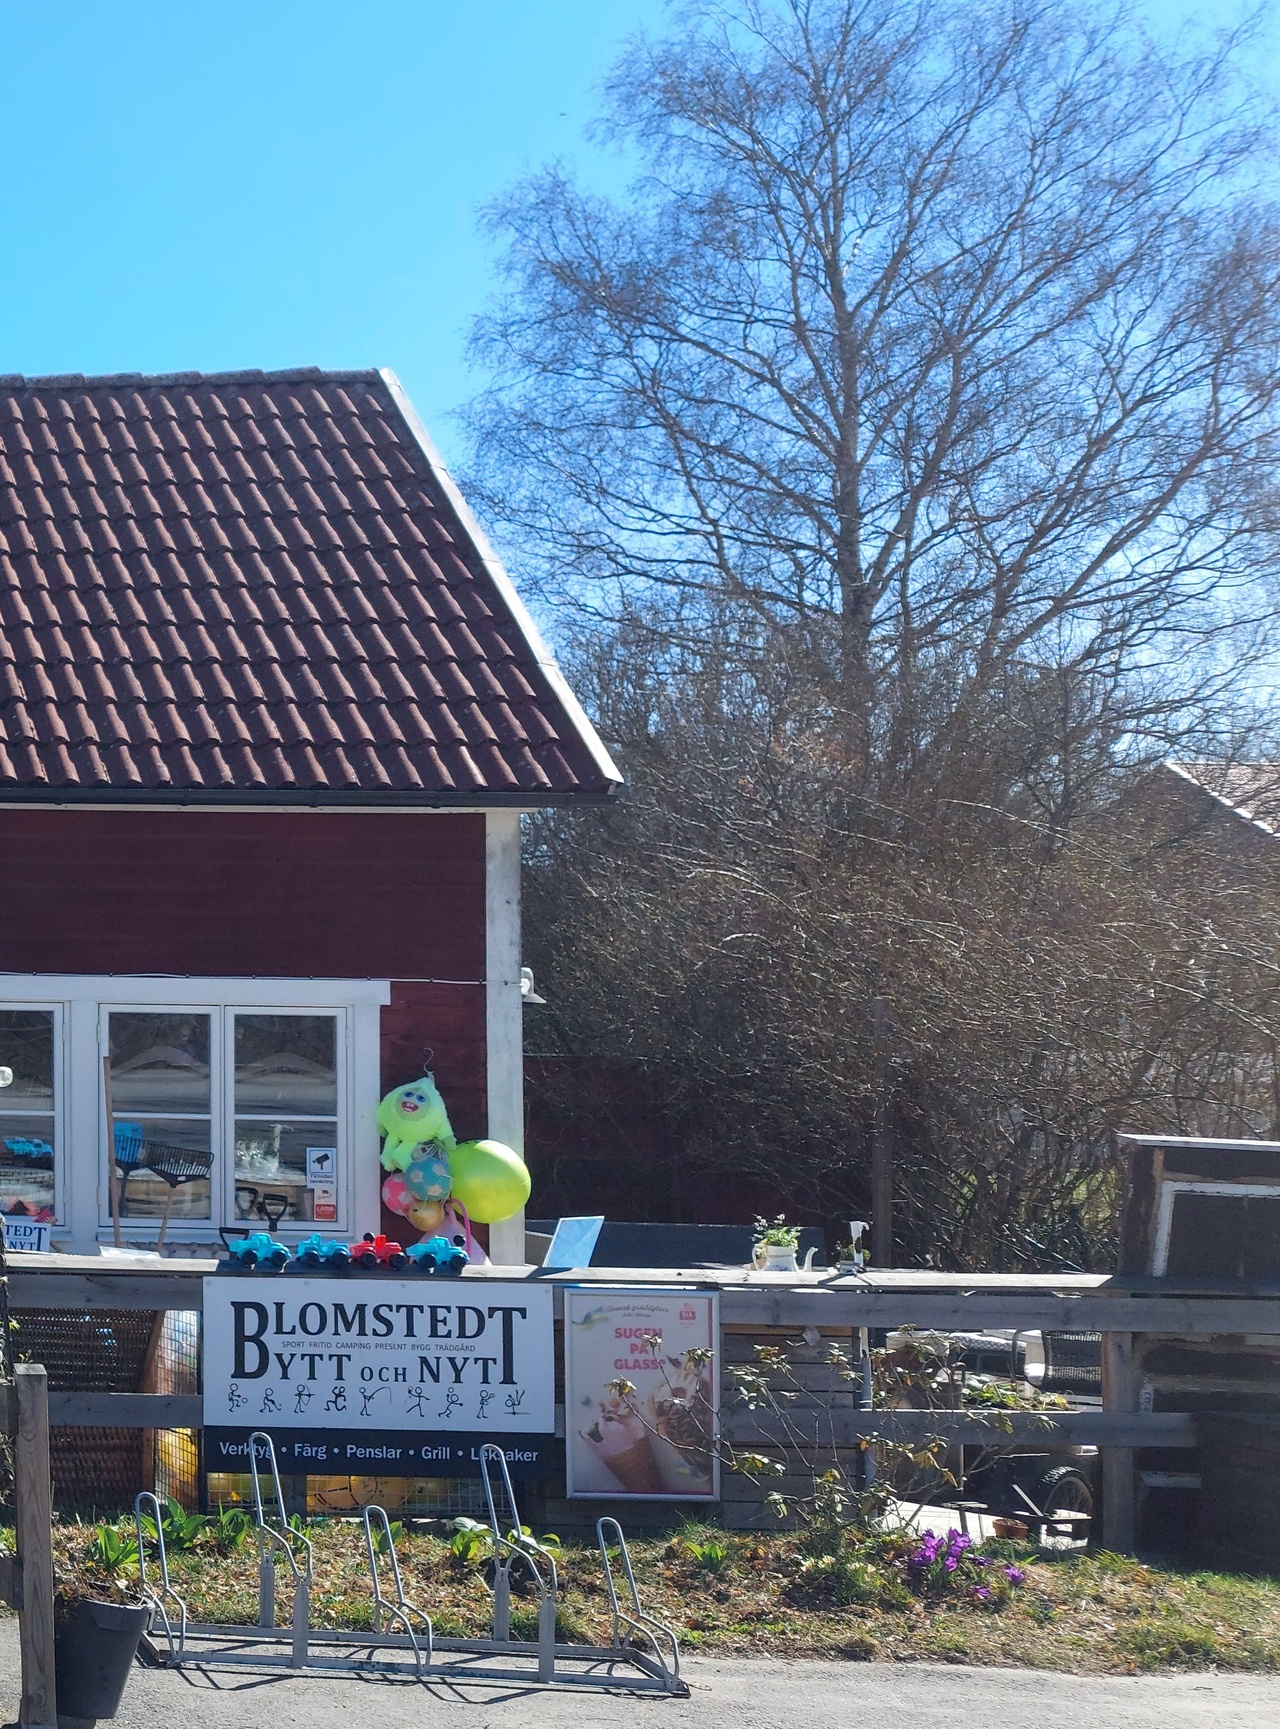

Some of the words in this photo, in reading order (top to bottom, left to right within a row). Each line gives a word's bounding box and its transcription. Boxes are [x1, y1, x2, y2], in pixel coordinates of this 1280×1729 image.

[614, 1327, 663, 1339] SUGEN
[230, 1300, 528, 1385] BLOMSTEDT
[282, 1340, 305, 1349] SPORT
[309, 1341, 333, 1349] FRITID
[336, 1342, 372, 1350] CAMPING
[411, 1343, 431, 1351] BYGG
[434, 1342, 476, 1352] TRÄDGÅRD
[360, 1365, 408, 1383] OCH
[294, 1443, 328, 1460] Färg
[346, 1444, 403, 1460] Penslar
[421, 1446, 450, 1460] Grill
[471, 1447, 539, 1462] Lekaker
